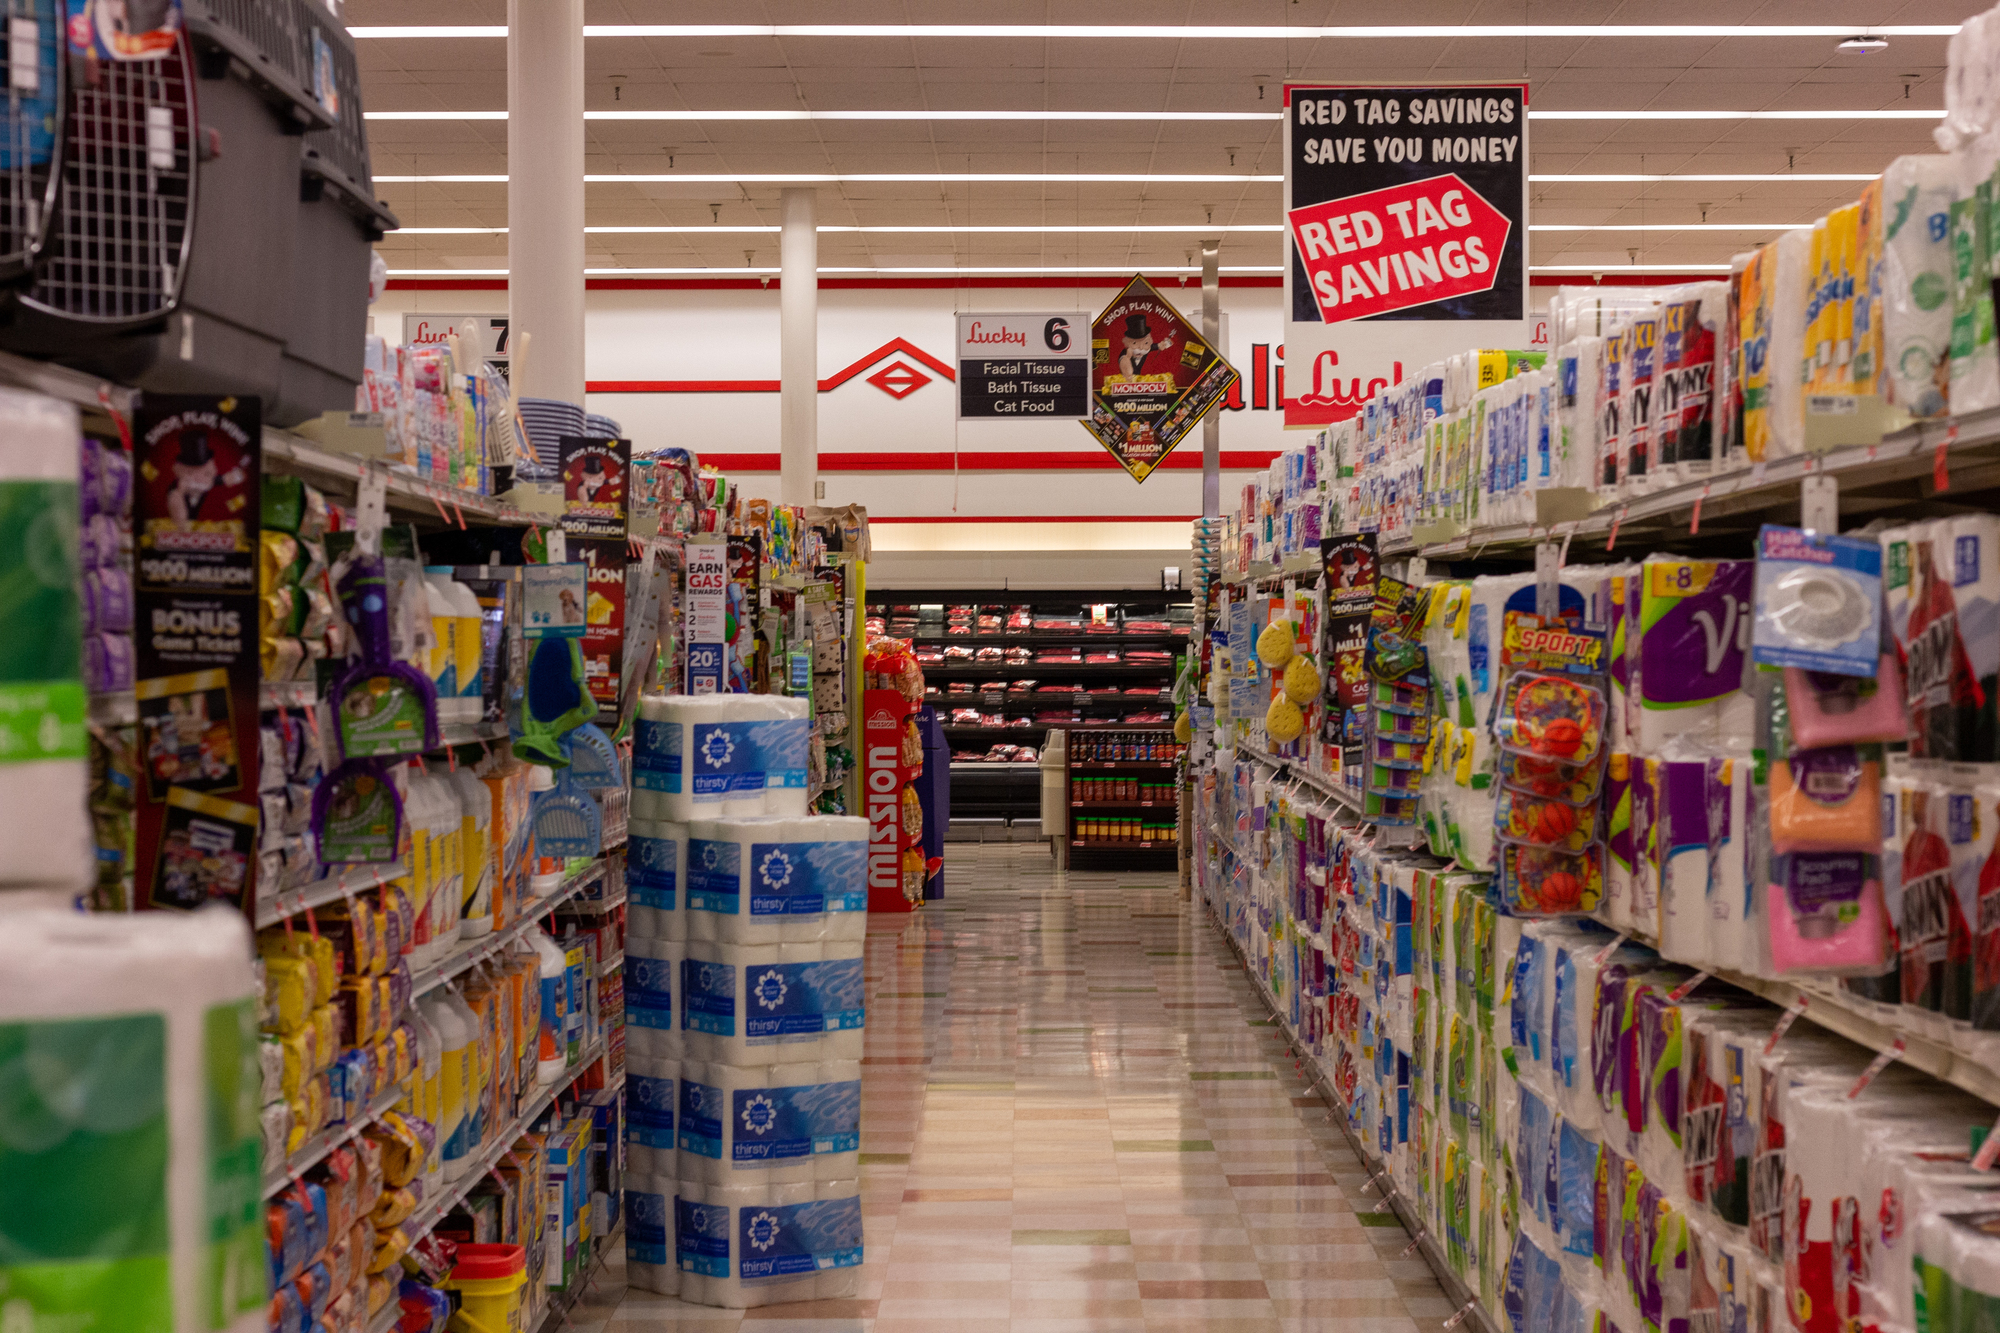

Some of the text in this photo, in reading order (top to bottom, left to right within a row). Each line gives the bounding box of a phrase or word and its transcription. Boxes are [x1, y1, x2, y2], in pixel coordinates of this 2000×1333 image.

[1299, 97, 1515, 125] RED TAG SAVINGS
[1303, 135, 1519, 165] SAVE YOU MONEY
[1299, 189, 1473, 261] RED TAG
[1314, 235, 1491, 309] SAVINGS
[1103, 301, 1177, 327] SHOP, PLAY, WIN!
[966, 317, 1071, 353] Lucky 6
[984, 362, 1066, 375] Facial Tissue
[988, 380, 1062, 394] Bath Tissue
[1114, 382, 1167, 395] MONOPOLY
[994, 400, 1055, 413] Cat Food
[1113, 401, 1168, 413] $200 MILLION
[1118, 442, 1163, 453] $1 MILLION
[566, 446, 625, 465] SHOP, PLAY, WIN!
[571, 508, 614, 518] MONOPOLY
[561, 521, 588, 534] $200
[588, 524, 625, 535] MILLION
[156, 532, 235, 549] MONOPOLY
[579, 548, 597, 567] $1
[1326, 542, 1372, 561] SHOP, PLAY, WIN!
[689, 563, 723, 574] EARN
[689, 575, 723, 588] GAS
[688, 588, 723, 596] REWARDS
[689, 602, 696, 612] 1
[1331, 602, 1353, 615] $200
[152, 609, 241, 636] BONUS
[688, 615, 697, 626] 2
[688, 630, 697, 641] 3
[1349, 623, 1363, 639] $1
[1520, 630, 1592, 656] SPORT
[690, 651, 713, 668] 20
[695, 776, 728, 791] thirsty
[753, 896, 787, 912] thirsty
[748, 1018, 781, 1034] thirsty
[735, 1143, 770, 1158] thirsty
[742, 1260, 775, 1275] thirsty
